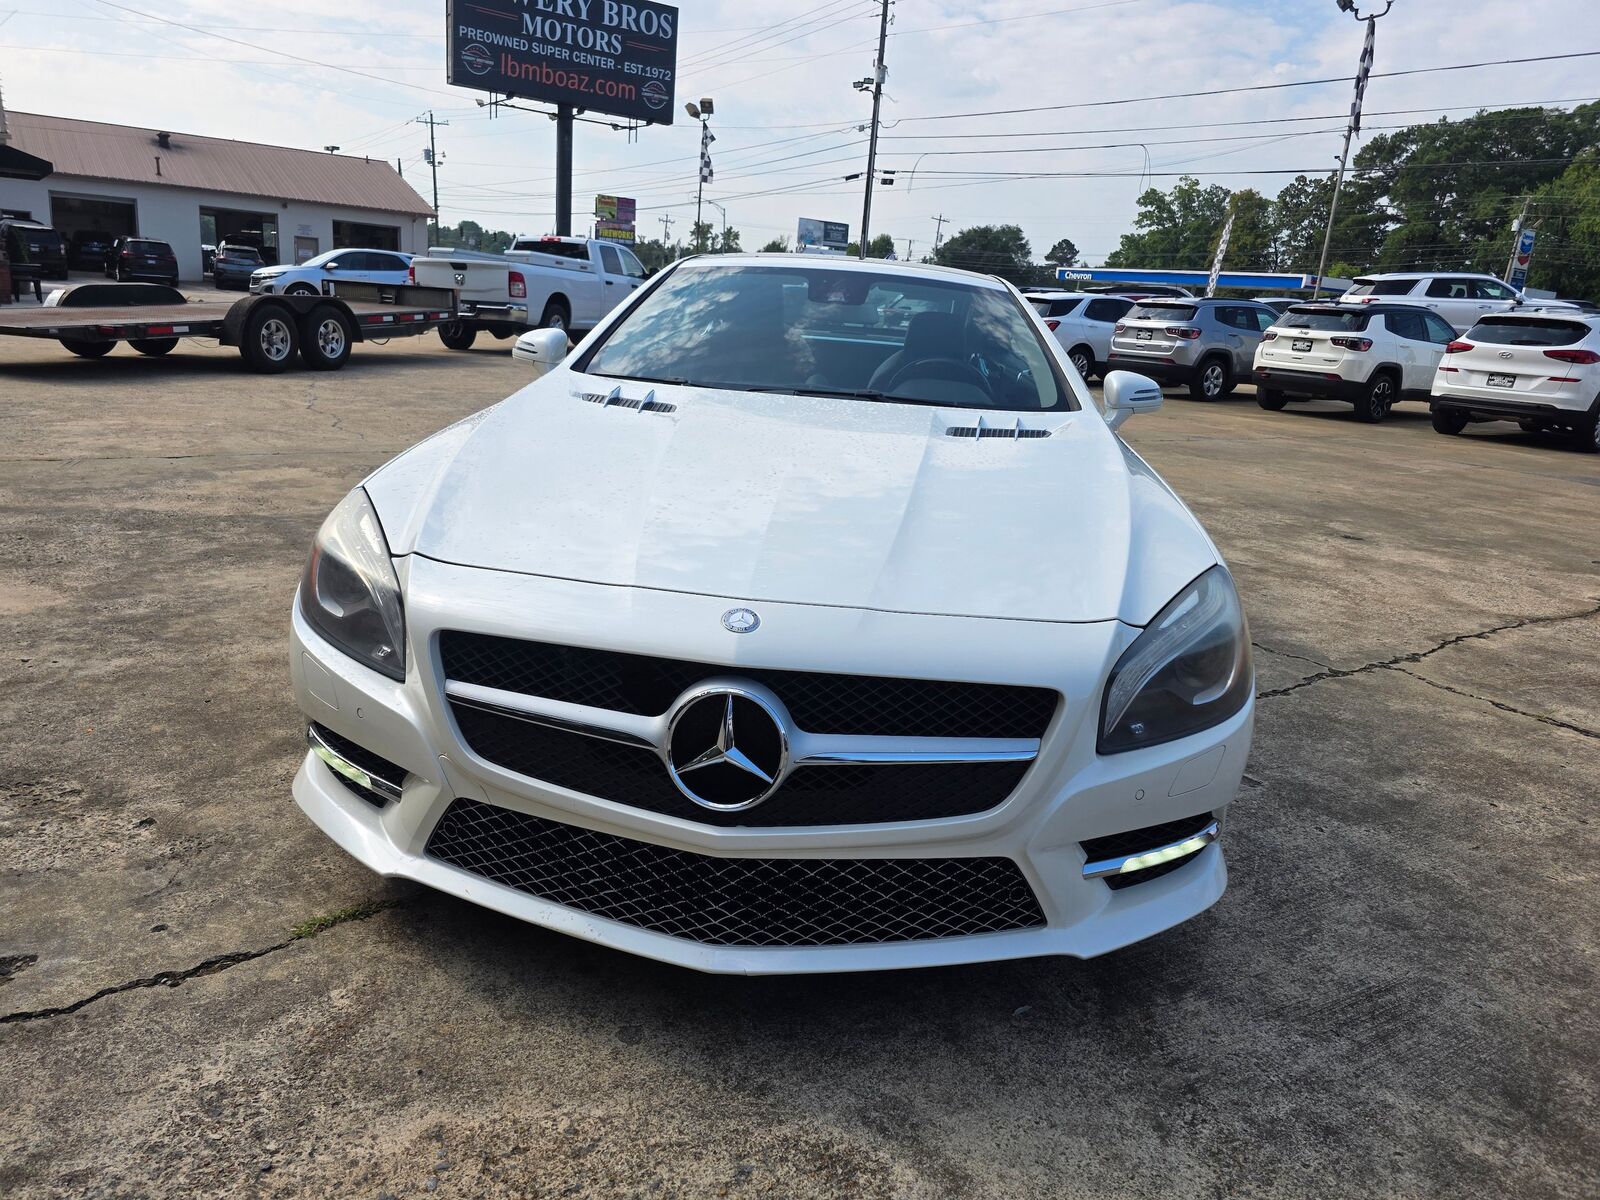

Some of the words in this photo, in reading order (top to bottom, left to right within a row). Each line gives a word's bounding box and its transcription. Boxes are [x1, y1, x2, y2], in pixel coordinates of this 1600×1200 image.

[521, 12, 622, 55] MOTORS
[601, 0, 673, 39] BROS
[459, 25, 529, 51] PREOWNED
[531, 42, 570, 60] SUPER
[572, 51, 615, 70] CENTER
[624, 61, 672, 81] EST.1972
[500, 52, 636, 101] lbmboaz.com
[599, 228, 634, 240] FIREWORKS
[1064, 271, 1092, 280] Chevron
